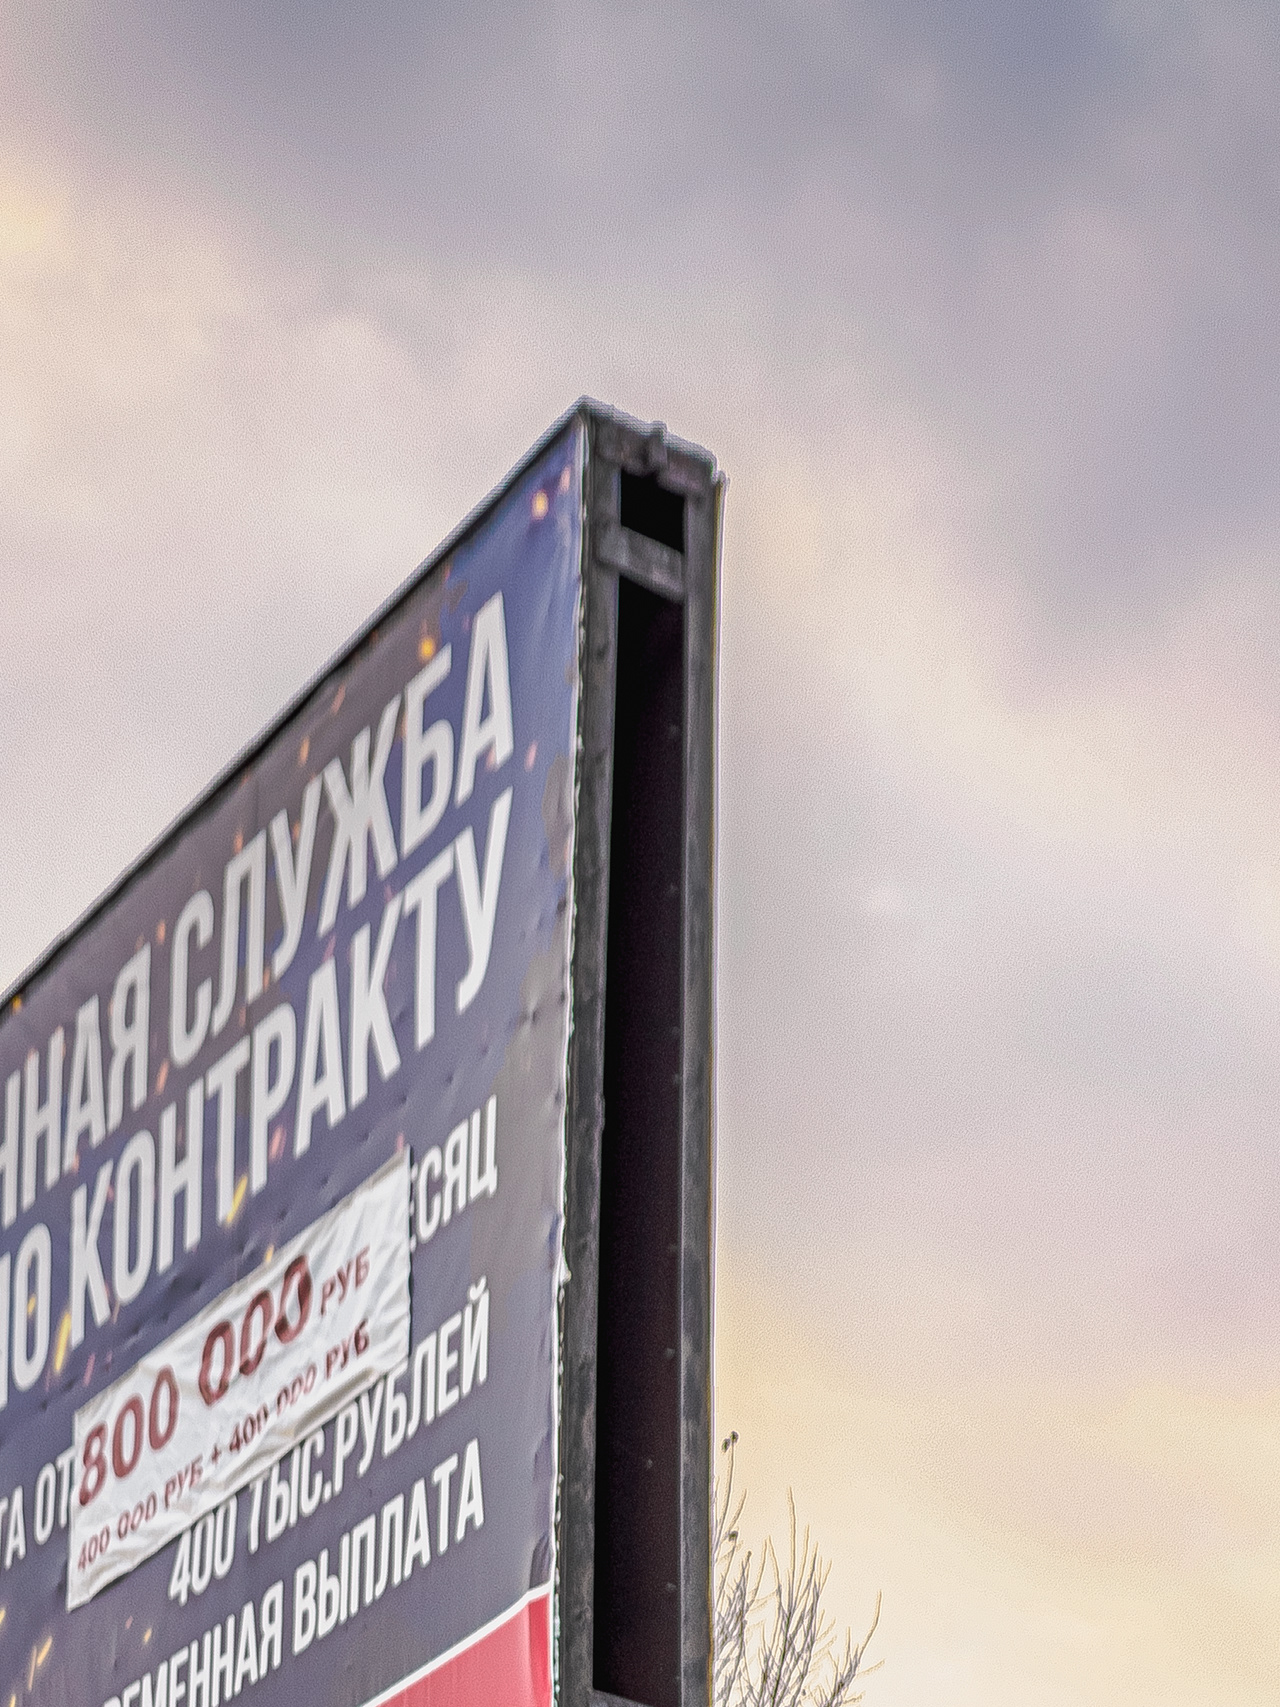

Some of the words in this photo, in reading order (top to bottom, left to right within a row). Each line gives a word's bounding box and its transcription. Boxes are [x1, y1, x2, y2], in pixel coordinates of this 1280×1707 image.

[168, 590, 515, 1069] СЛУЖБА
[68, 785, 513, 1348] КОНТРАКТУ
[34, 1449, 76, 1546] ОТ
[78, 1364, 180, 1506] 800
[198, 1255, 312, 1409] 000
[320, 1246, 371, 1316] РУБ
[78, 1524, 110, 1570] 400
[117, 1491, 157, 1540] 000
[164, 1455, 203, 1508] РУБ
[325, 1318, 371, 1379] РУБ
[169, 1494, 237, 1606] 400
[247, 1276, 490, 1555] ТЫС.РУБЛЕЙ
[293, 1438, 484, 1656] ВЫПЛАТА
